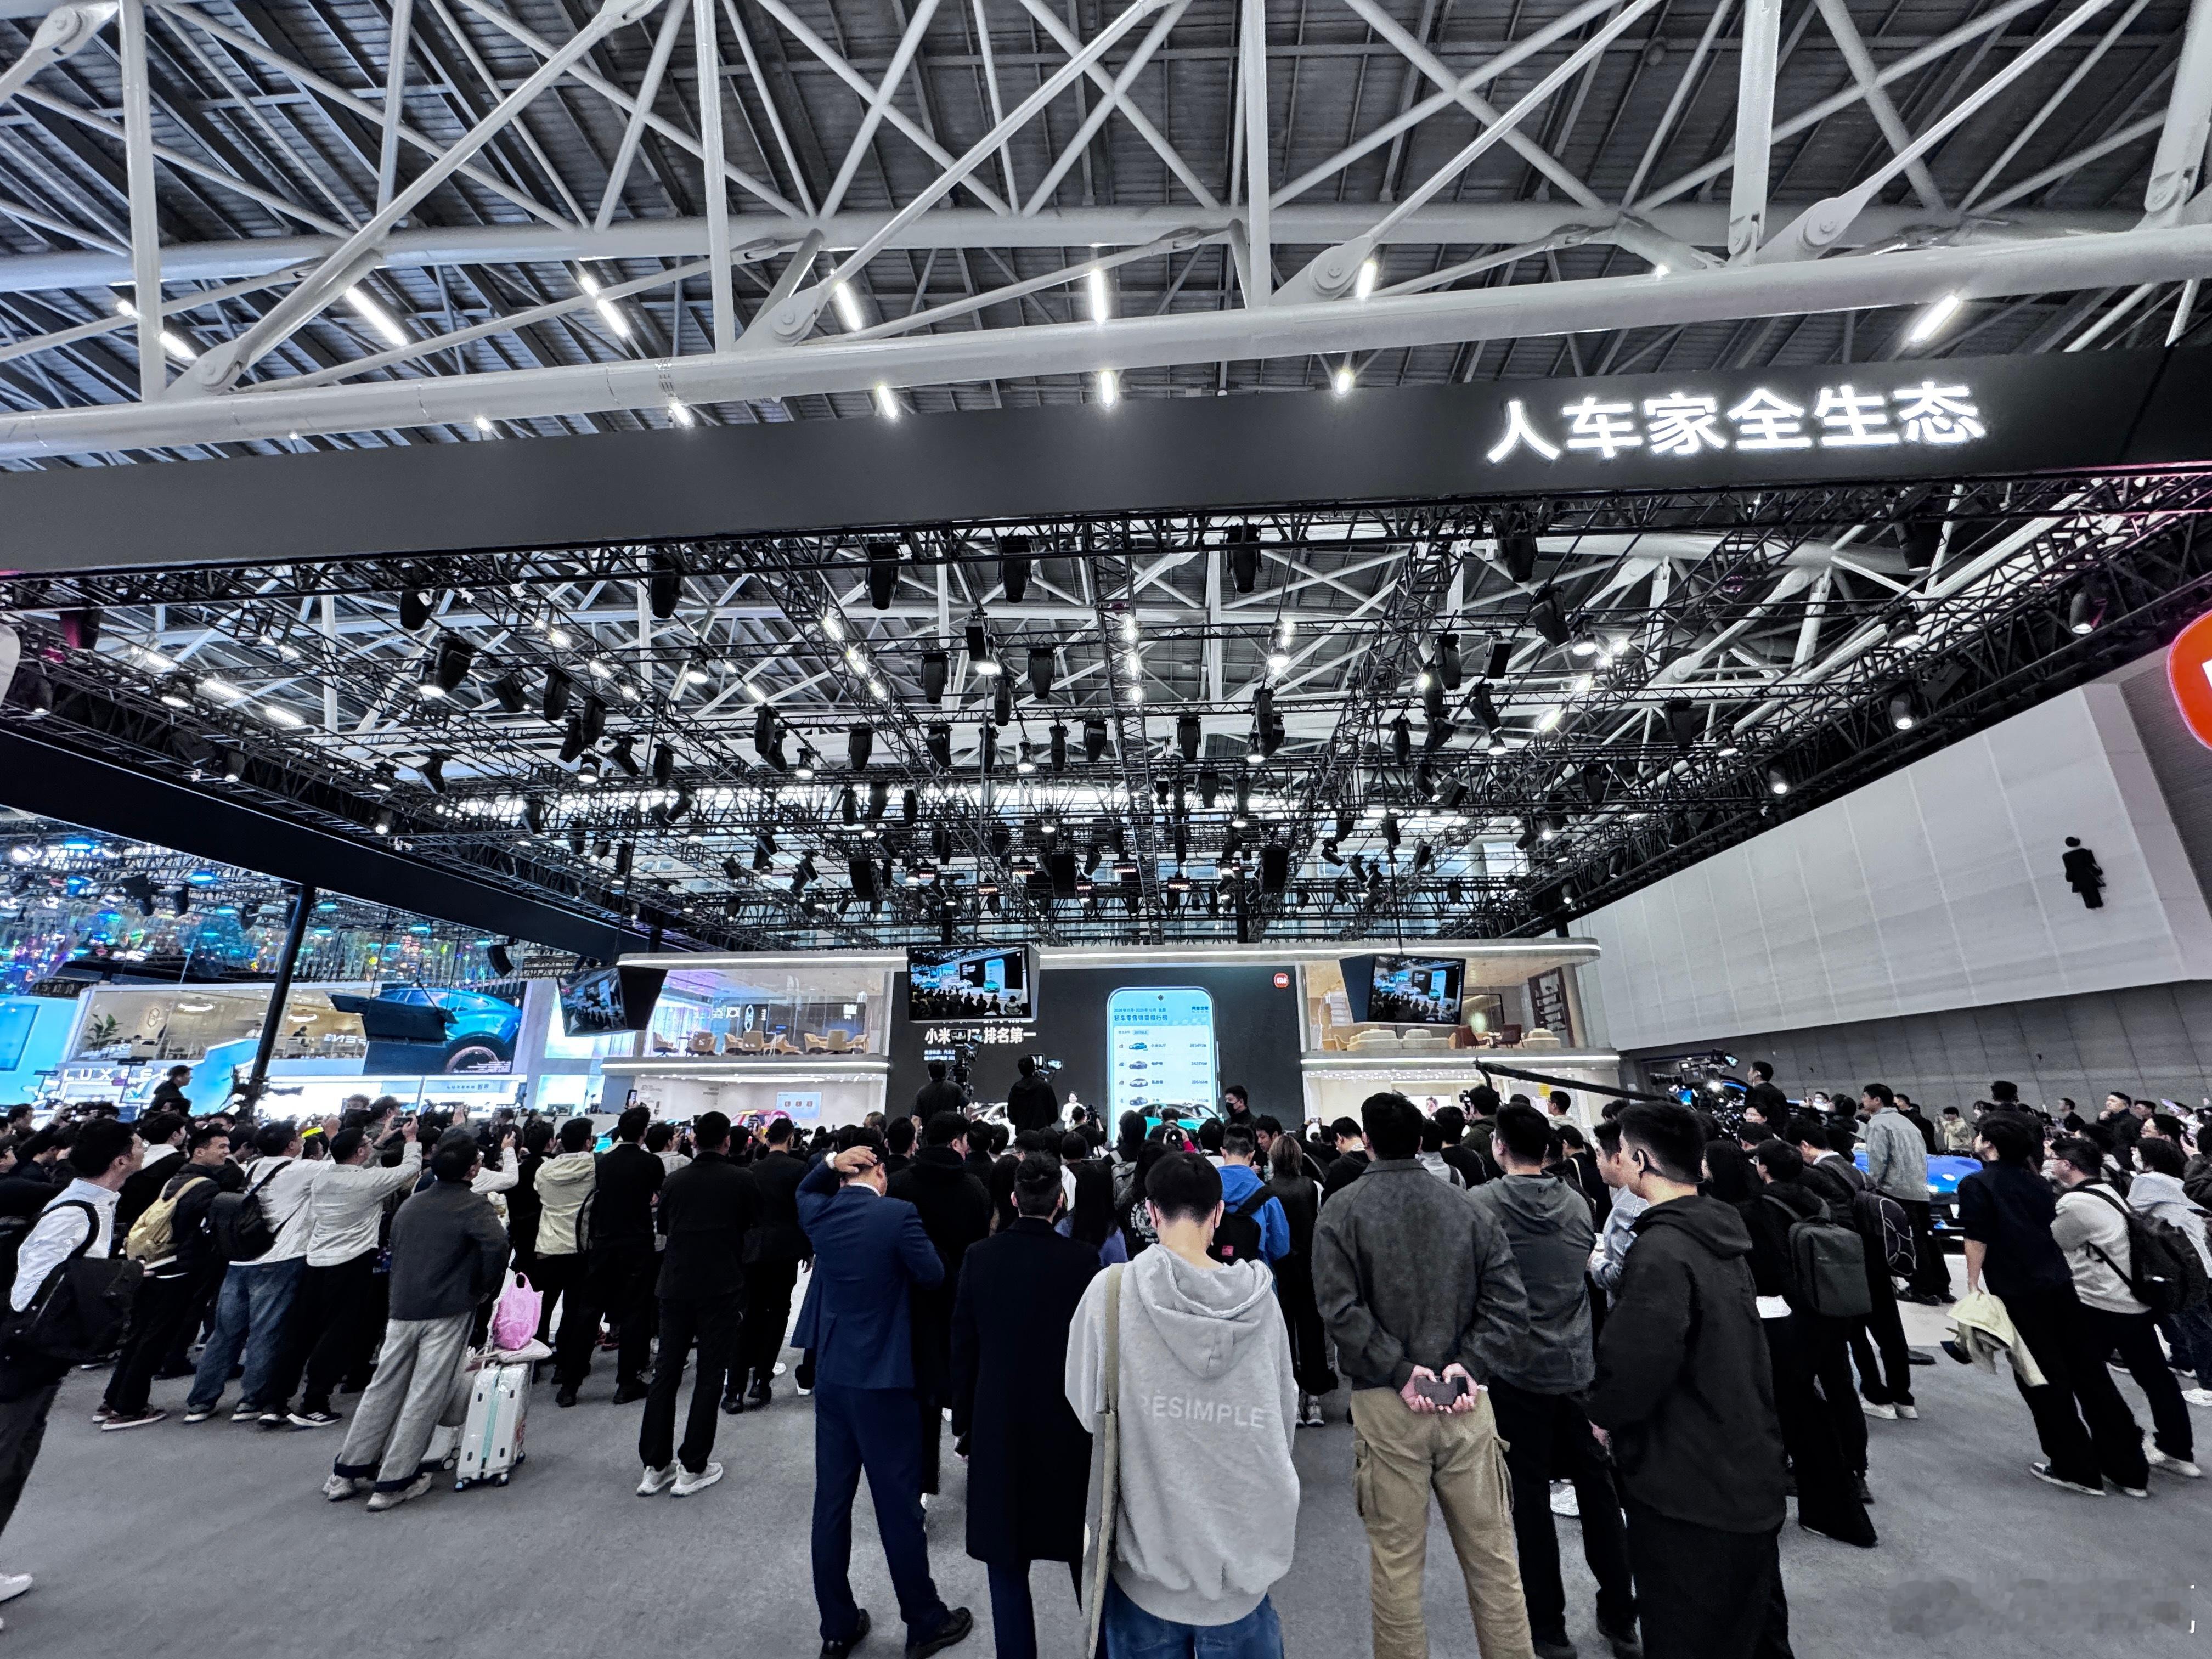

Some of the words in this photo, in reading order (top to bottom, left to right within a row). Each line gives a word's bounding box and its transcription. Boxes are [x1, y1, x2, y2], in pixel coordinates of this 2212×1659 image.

[1487, 380, 1986, 462] 人车家全生态
